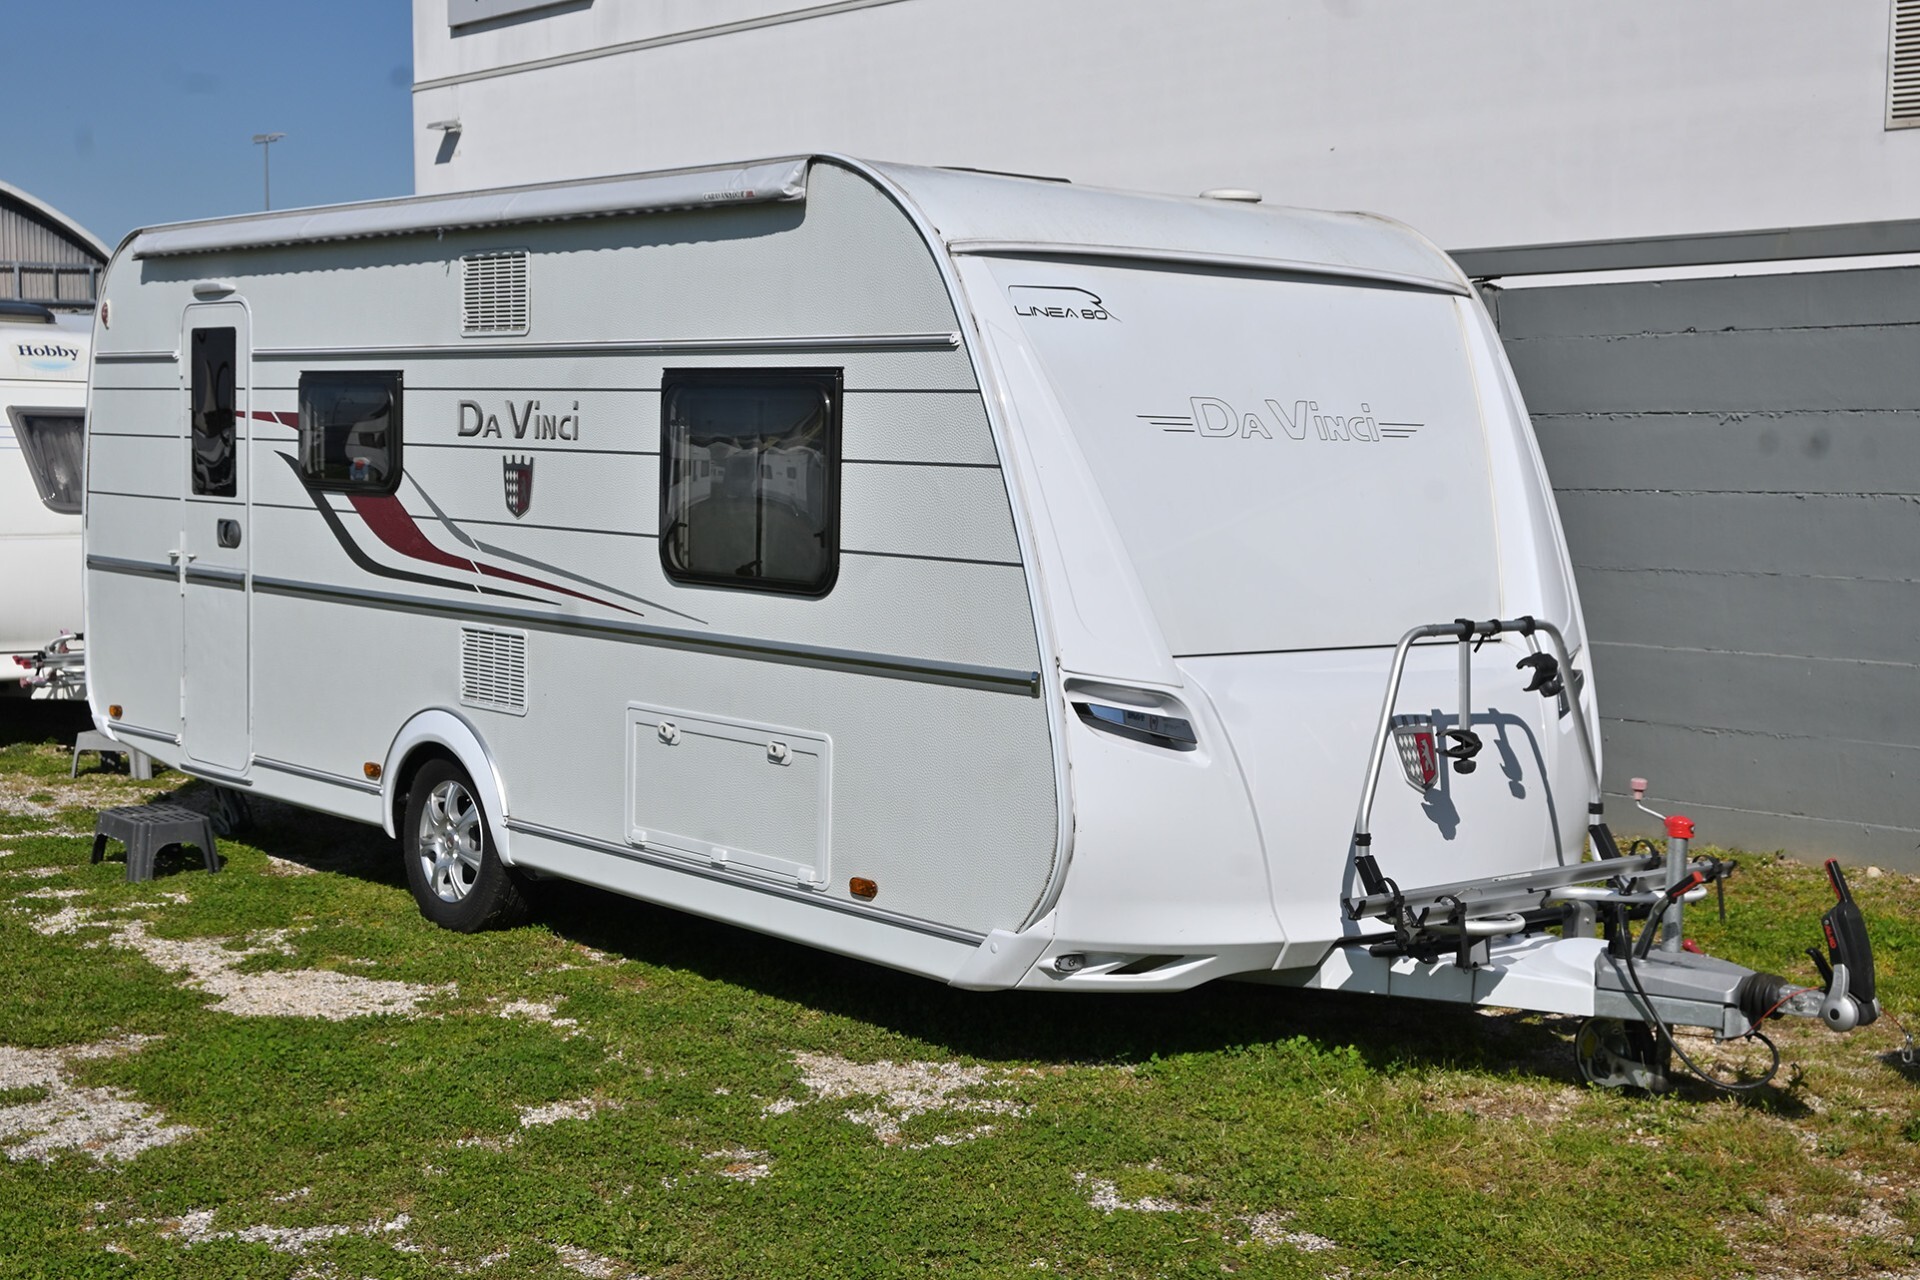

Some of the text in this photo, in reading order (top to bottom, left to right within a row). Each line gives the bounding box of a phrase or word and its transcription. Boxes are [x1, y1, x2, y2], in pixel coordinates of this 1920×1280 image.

[1013, 304, 1108, 320] LINEA 80
[17, 344, 79, 361] Hobby
